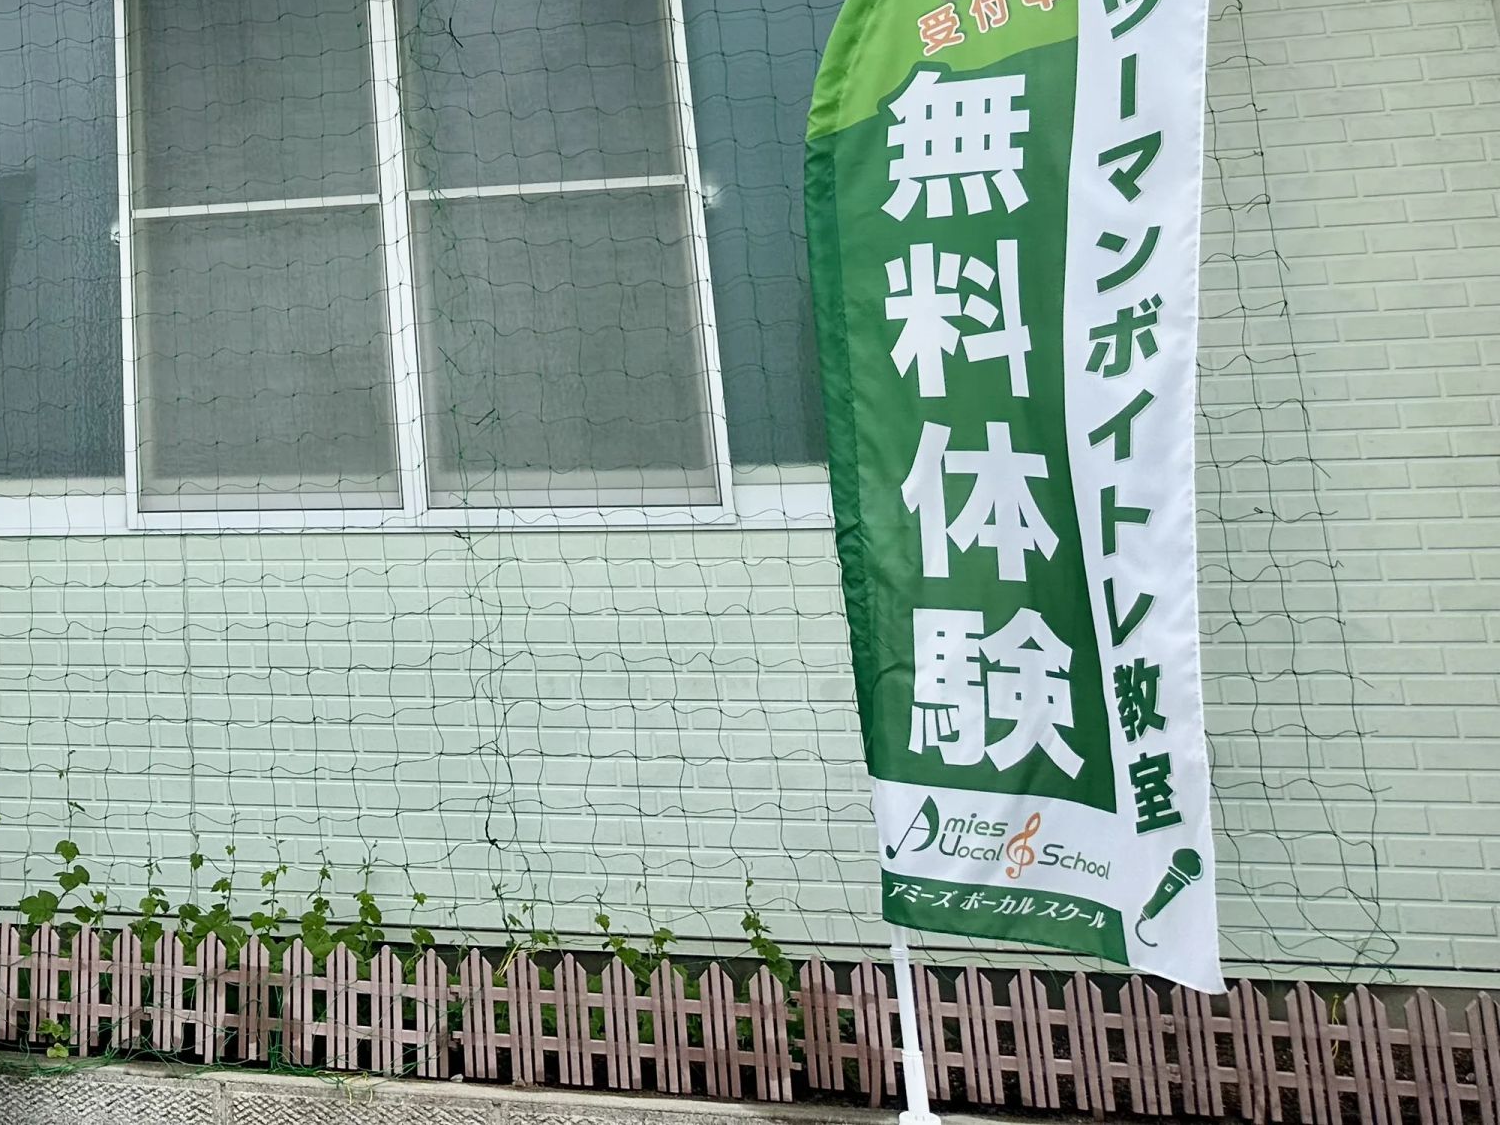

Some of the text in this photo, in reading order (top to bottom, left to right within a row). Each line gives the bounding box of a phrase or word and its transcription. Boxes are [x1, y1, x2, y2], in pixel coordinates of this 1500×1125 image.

[880, 70, 1086, 780] 無料体験
[1038, 843, 1111, 880] School
[888, 882, 1107, 928] アミーズ ボーカル スクール
